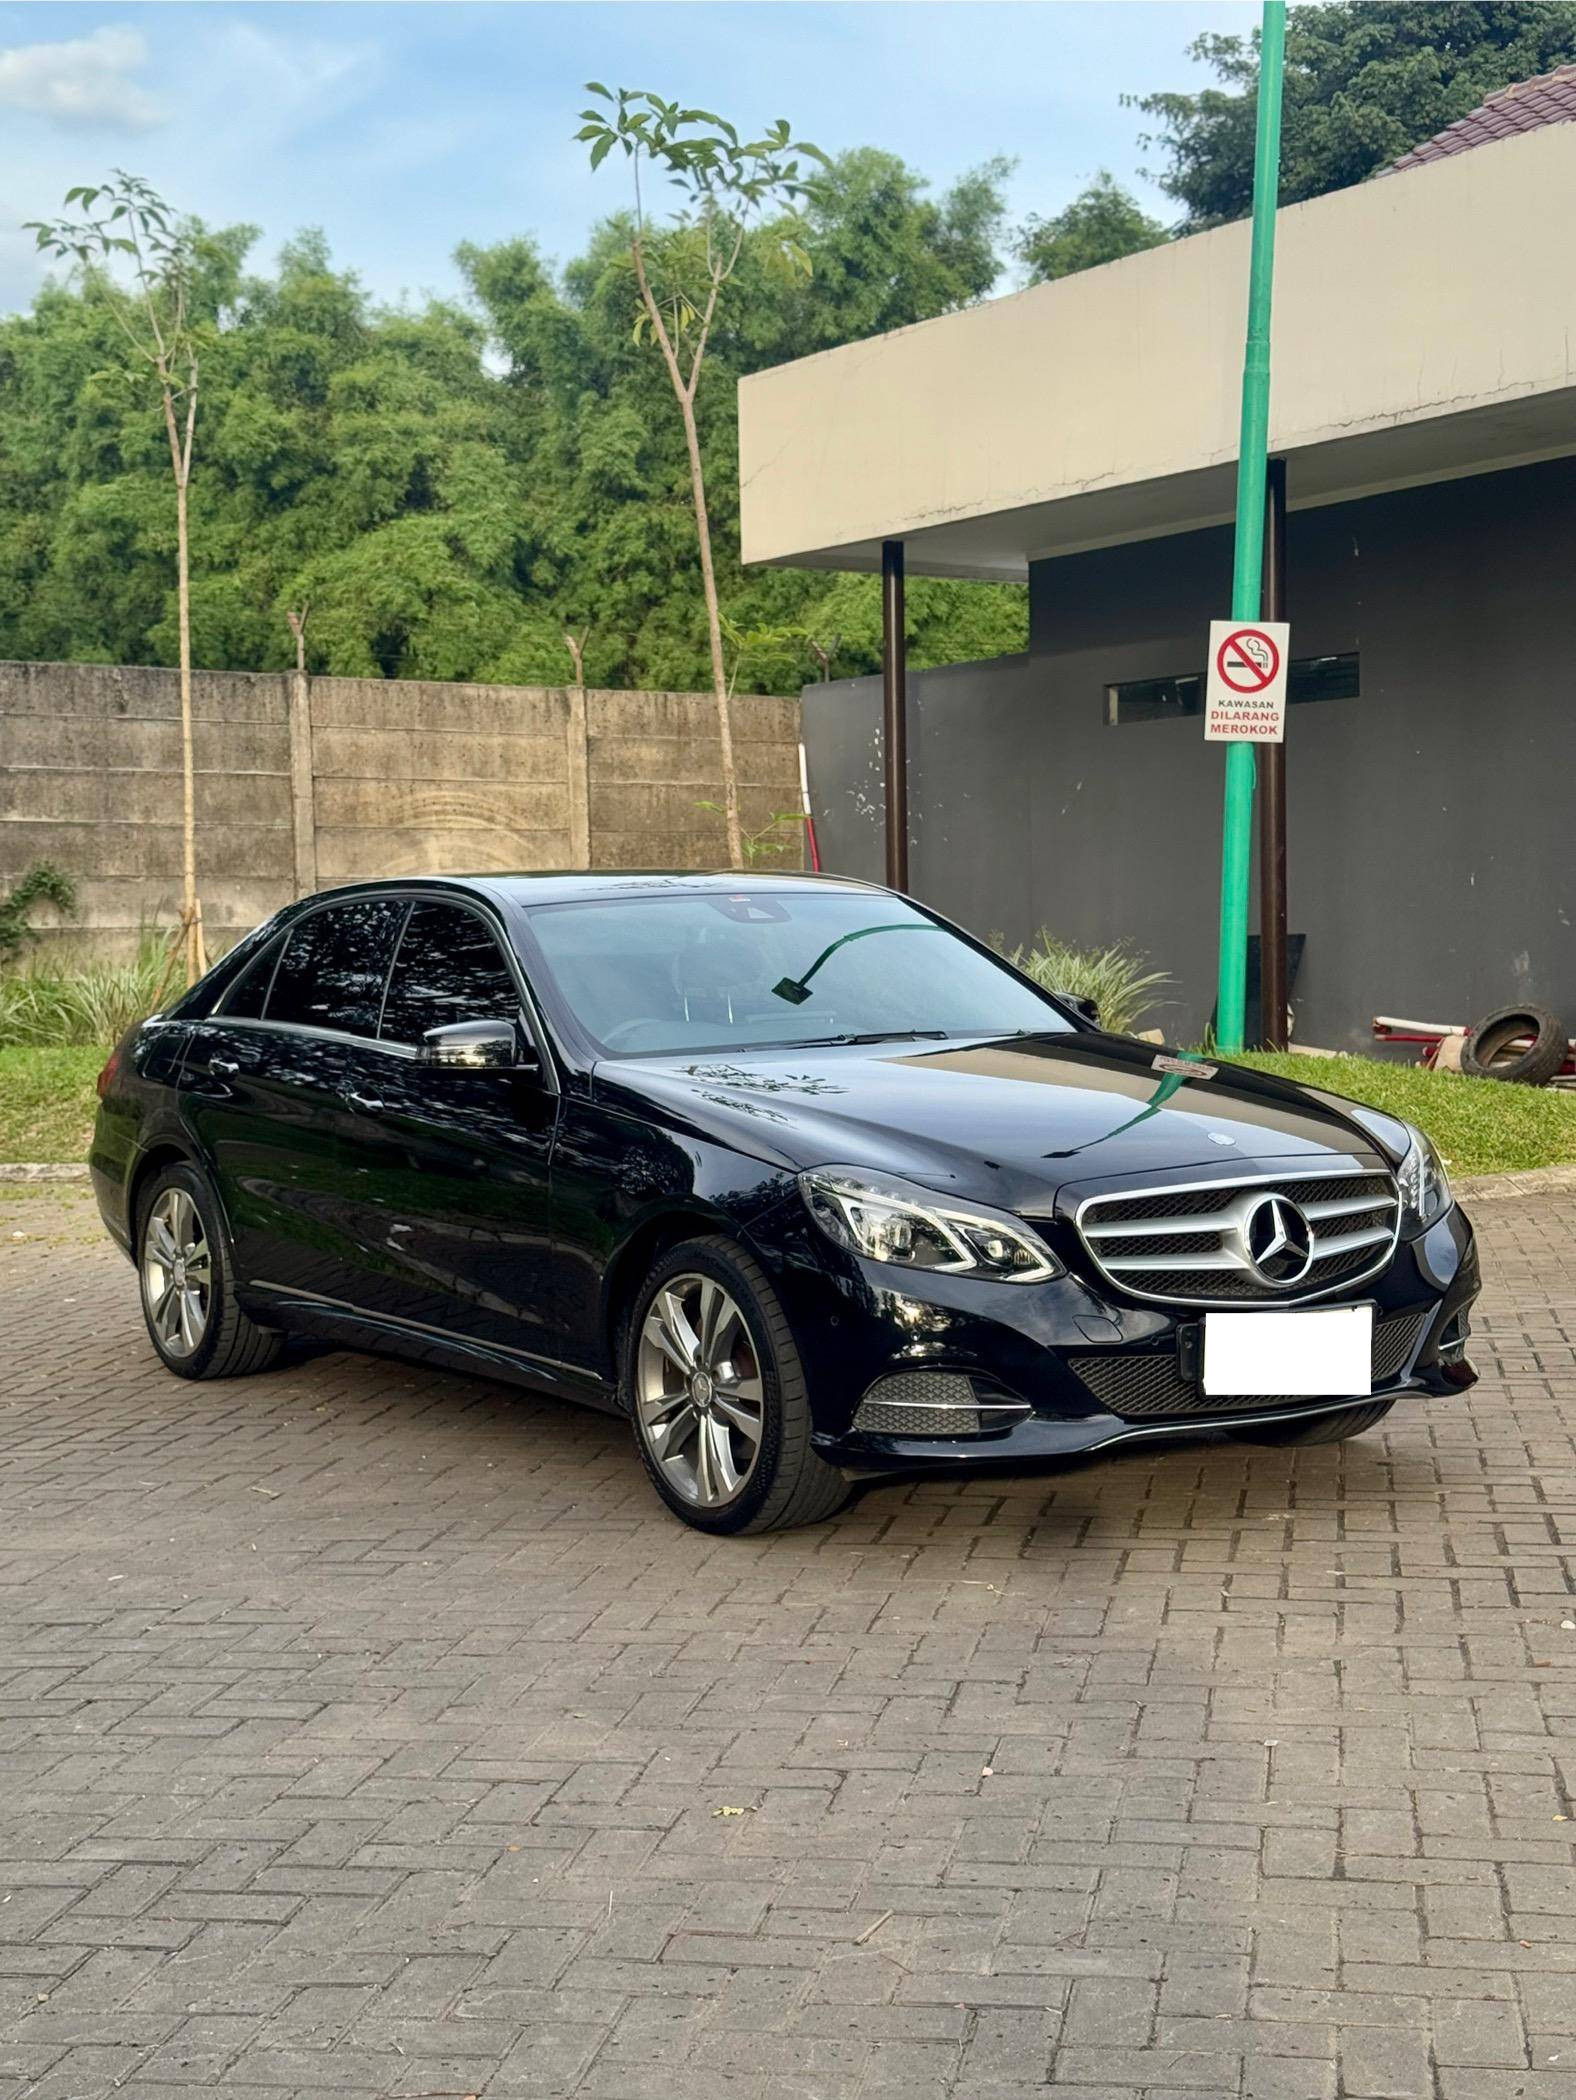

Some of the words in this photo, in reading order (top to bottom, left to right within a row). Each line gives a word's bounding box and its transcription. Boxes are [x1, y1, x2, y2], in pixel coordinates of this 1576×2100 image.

[1218, 700, 1274, 709] KAWASAN
[1211, 711, 1280, 721] DILARANG
[1210, 724, 1278, 735] MEROKOK
